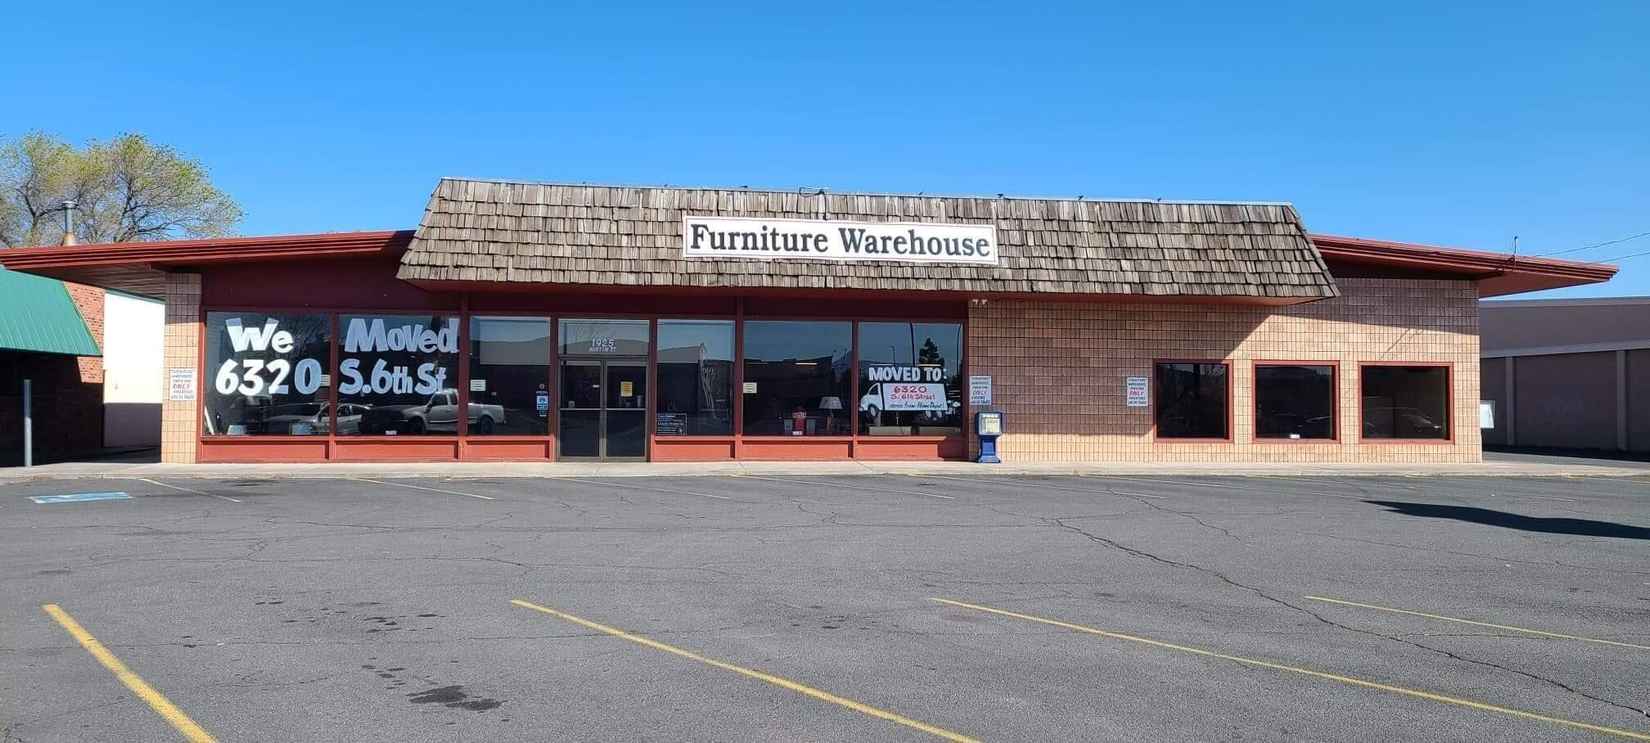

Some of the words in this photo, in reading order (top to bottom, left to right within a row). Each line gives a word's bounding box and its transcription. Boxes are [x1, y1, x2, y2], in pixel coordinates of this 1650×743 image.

[690, 223, 829, 253] Furniture
[838, 227, 990, 257] Warehouse
[225, 317, 295, 353] We
[344, 318, 460, 353] Moved
[215, 358, 322, 396] 6320
[869, 367, 920, 381] MOVED
[894, 385, 927, 393] 6320
